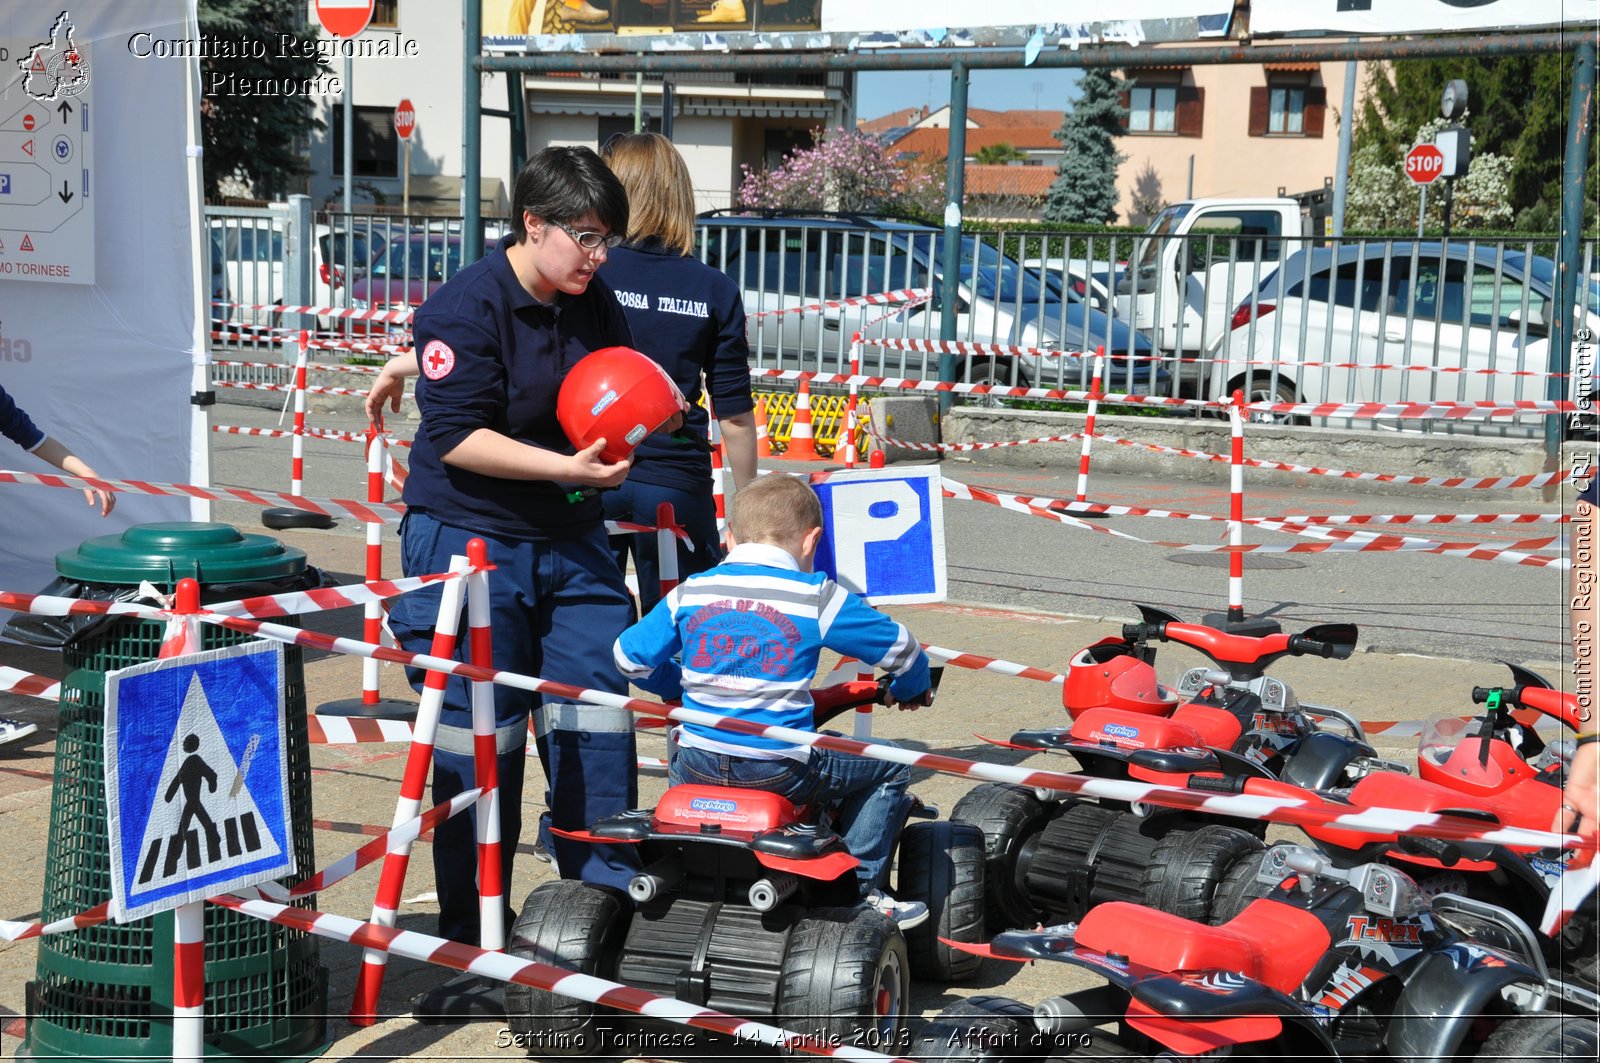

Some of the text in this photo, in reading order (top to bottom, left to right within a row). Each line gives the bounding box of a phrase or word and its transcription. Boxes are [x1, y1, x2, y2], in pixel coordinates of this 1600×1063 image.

[395, 110, 415, 127] STOP
[1408, 155, 1442, 172] STOP
[15, 263, 70, 277] TORINESE
[657, 297, 709, 317] ITALIANA
[832, 480, 921, 594] P
[736, 599, 754, 612] OF
[1252, 713, 1297, 735] T-Rex
[1346, 915, 1425, 944] T-Rex
